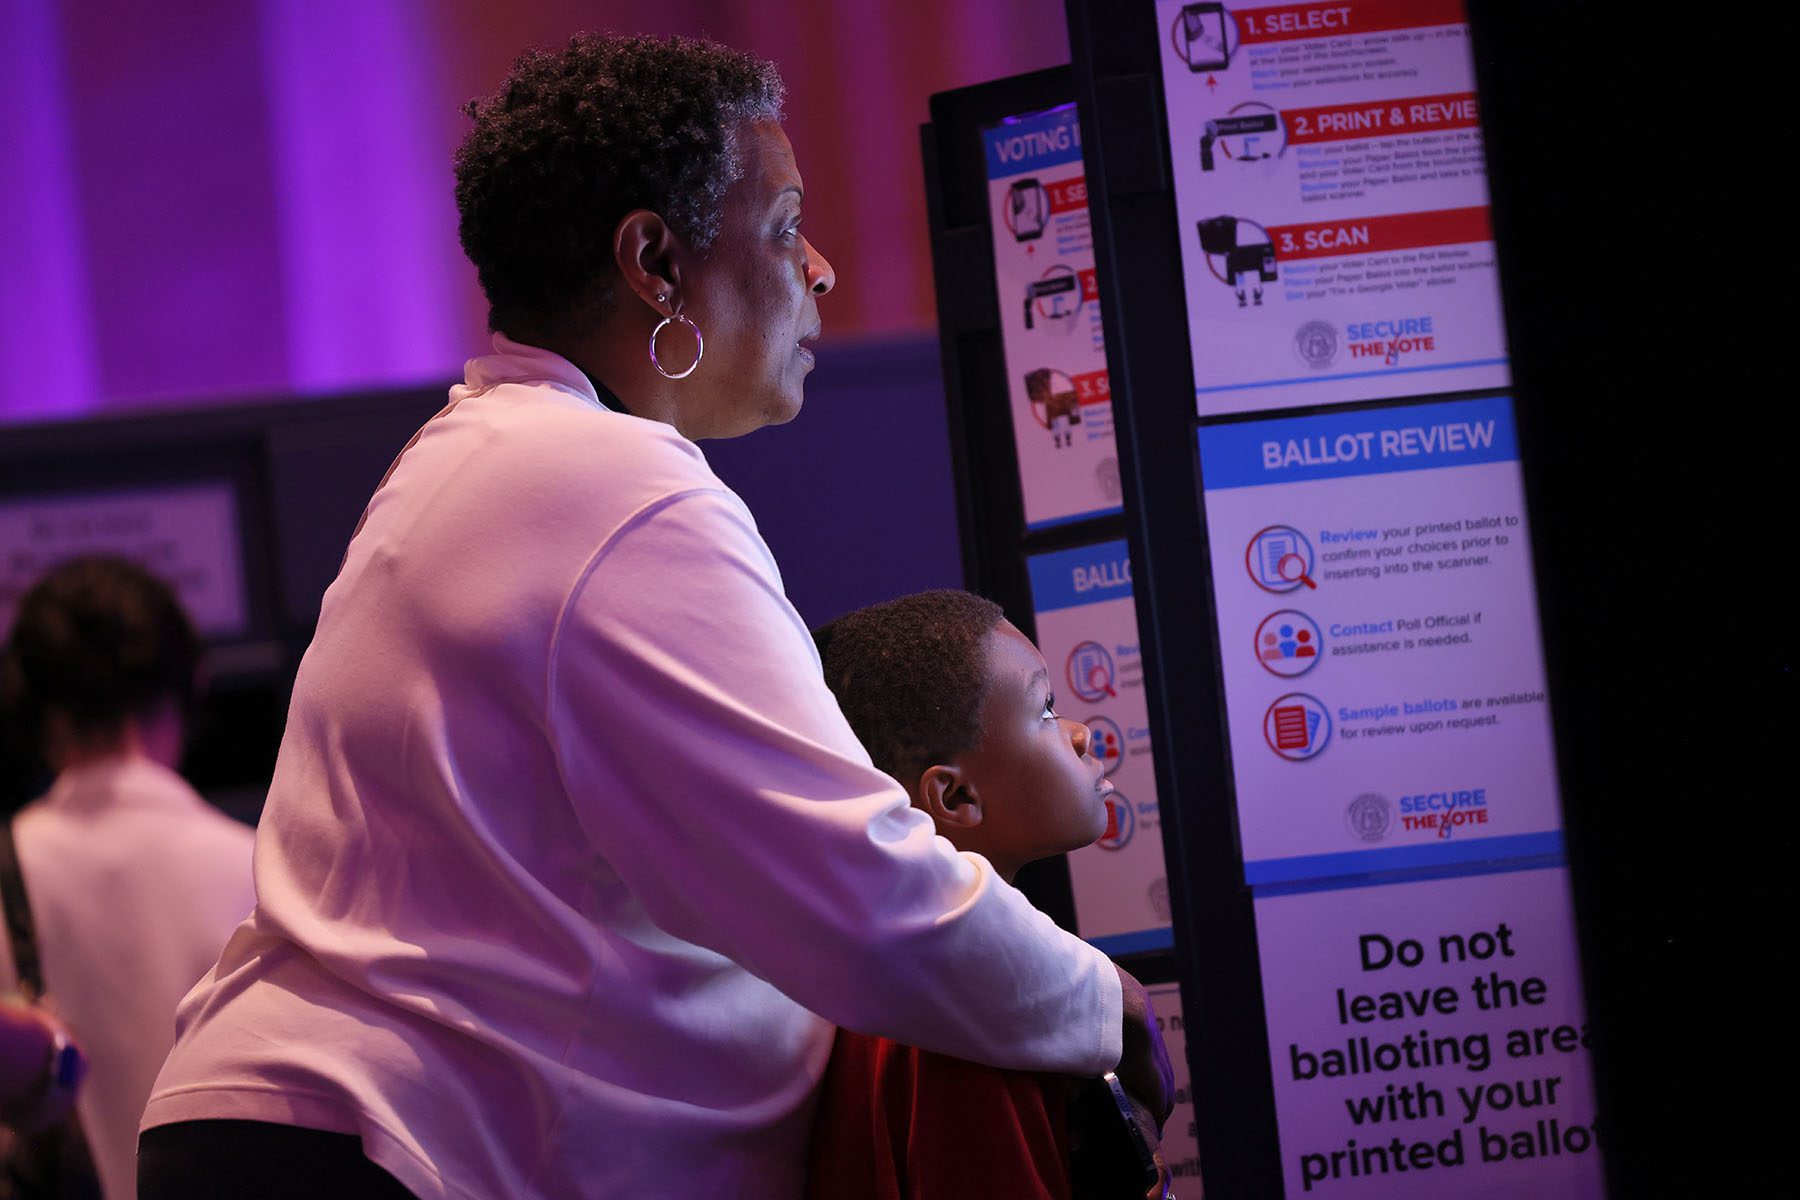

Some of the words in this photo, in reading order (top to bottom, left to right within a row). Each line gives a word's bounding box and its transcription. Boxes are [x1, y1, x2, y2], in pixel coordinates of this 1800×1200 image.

[1245, 16, 1261, 35] 1.
[1265, 7, 1351, 33] SELECT
[1295, 117, 1314, 135] 2.
[1318, 109, 1384, 133] PRINT
[1389, 107, 1405, 126] &
[1410, 100, 1478, 124] REVIE
[995, 126, 1070, 164] VOTING
[1281, 233, 1300, 252] 3.
[1304, 225, 1369, 250] SCAN
[1347, 317, 1432, 340] SECURE
[1349, 342, 1385, 358] THE
[1263, 434, 1374, 470] BALLOT
[1380, 420, 1496, 457] REVIEW
[1320, 529, 1378, 544] Review
[1382, 527, 1411, 541] your
[1415, 518, 1462, 536] printed
[1465, 515, 1501, 530] ballot
[1505, 514, 1519, 527] to
[1322, 548, 1371, 563] confirm
[1375, 546, 1403, 560] your
[1407, 540, 1458, 555] choices
[1462, 535, 1492, 550] prior
[1495, 534, 1509, 547] to
[1072, 559, 1132, 592] BALLO
[1323, 563, 1381, 580] inserting
[1384, 562, 1409, 575] into
[1413, 559, 1433, 572] the
[1438, 554, 1492, 570] scanner.
[1329, 620, 1393, 637] Contact
[1397, 618, 1421, 631] Poll
[1424, 613, 1470, 628] Official
[1473, 611, 1482, 624] if
[1332, 640, 1400, 656] assistance
[1404, 637, 1415, 649] is
[1418, 632, 1473, 648] needed.
[1338, 703, 1399, 721] Sample
[1403, 698, 1458, 715] ballots
[1462, 698, 1482, 709] are
[1486, 691, 1546, 707] available
[1340, 727, 1358, 739] for
[1362, 723, 1406, 737] review
[1410, 719, 1443, 734] upon
[1447, 714, 1500, 730] request.
[1400, 789, 1486, 813] SECURE
[1402, 814, 1437, 831] THE
[1358, 933, 1425, 972] Do
[1439, 923, 1515, 963] not
[1336, 987, 1459, 1025] leave
[1471, 972, 1547, 1011] the
[1290, 1029, 1492, 1081] balloting
[1346, 1081, 1445, 1125] with
[1457, 1076, 1562, 1124] your
[1299, 1129, 1465, 1192] printed
